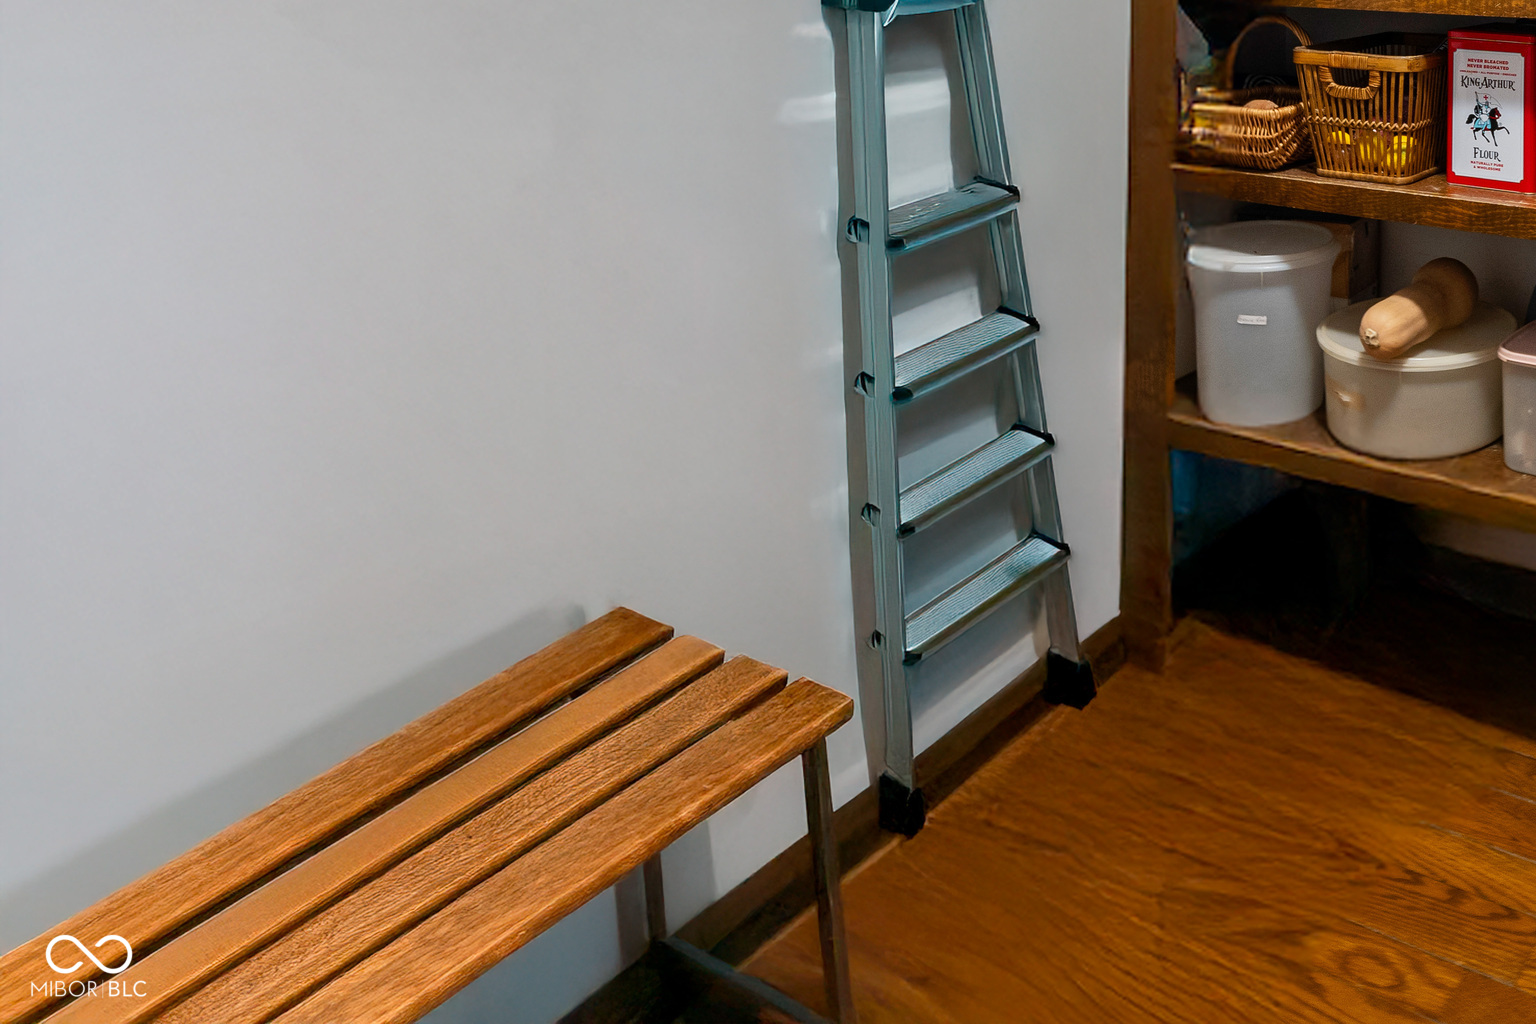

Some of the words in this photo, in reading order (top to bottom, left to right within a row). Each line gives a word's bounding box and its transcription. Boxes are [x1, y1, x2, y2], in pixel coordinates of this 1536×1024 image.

[1460, 75, 1480, 89] KING
[1479, 76, 1515, 91] ARTHUR
[1473, 147, 1501, 162] FLOUR
[1470, 160, 1492, 168] NATURALLY
